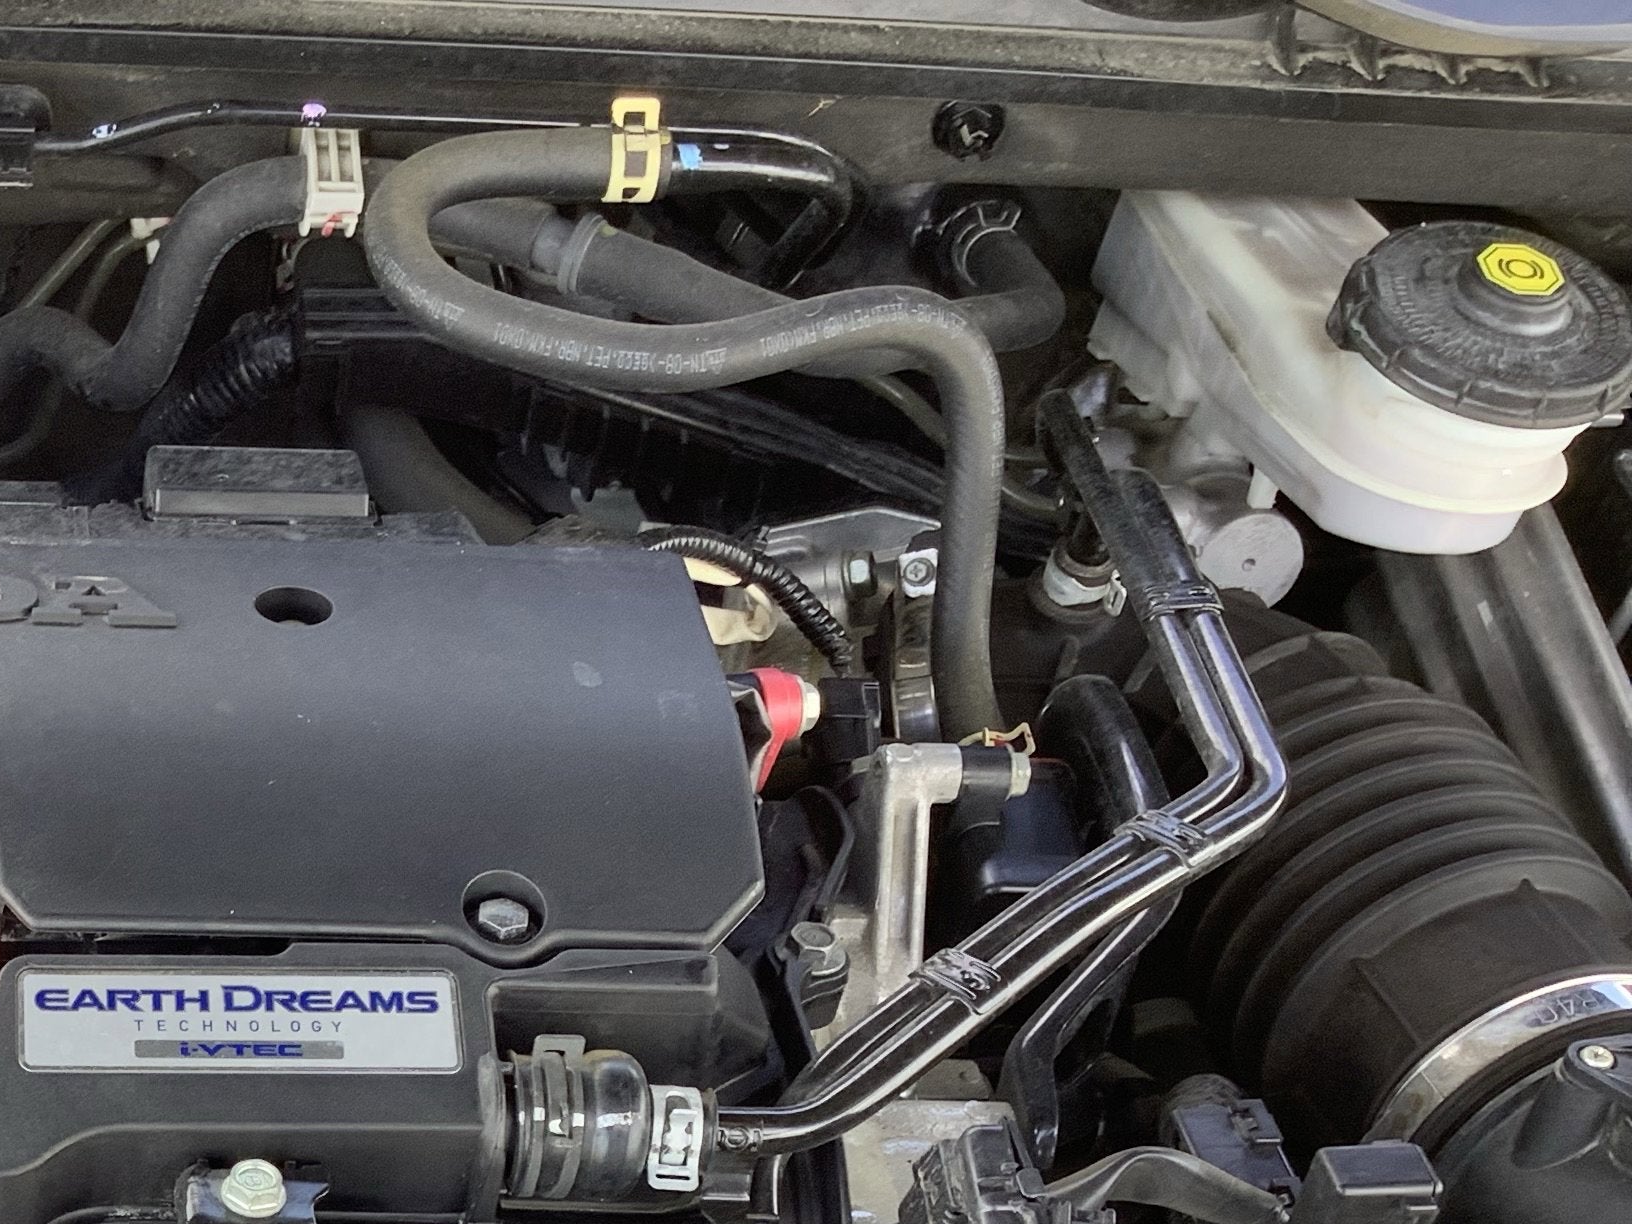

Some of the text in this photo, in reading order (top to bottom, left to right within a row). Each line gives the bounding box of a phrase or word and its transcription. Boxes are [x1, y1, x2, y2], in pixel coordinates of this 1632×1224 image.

[33, 984, 441, 1015] EARTH DREAMS
[133, 1019, 344, 1033] TECHNOLOGY
[179, 1042, 305, 1058] i-VTEC
